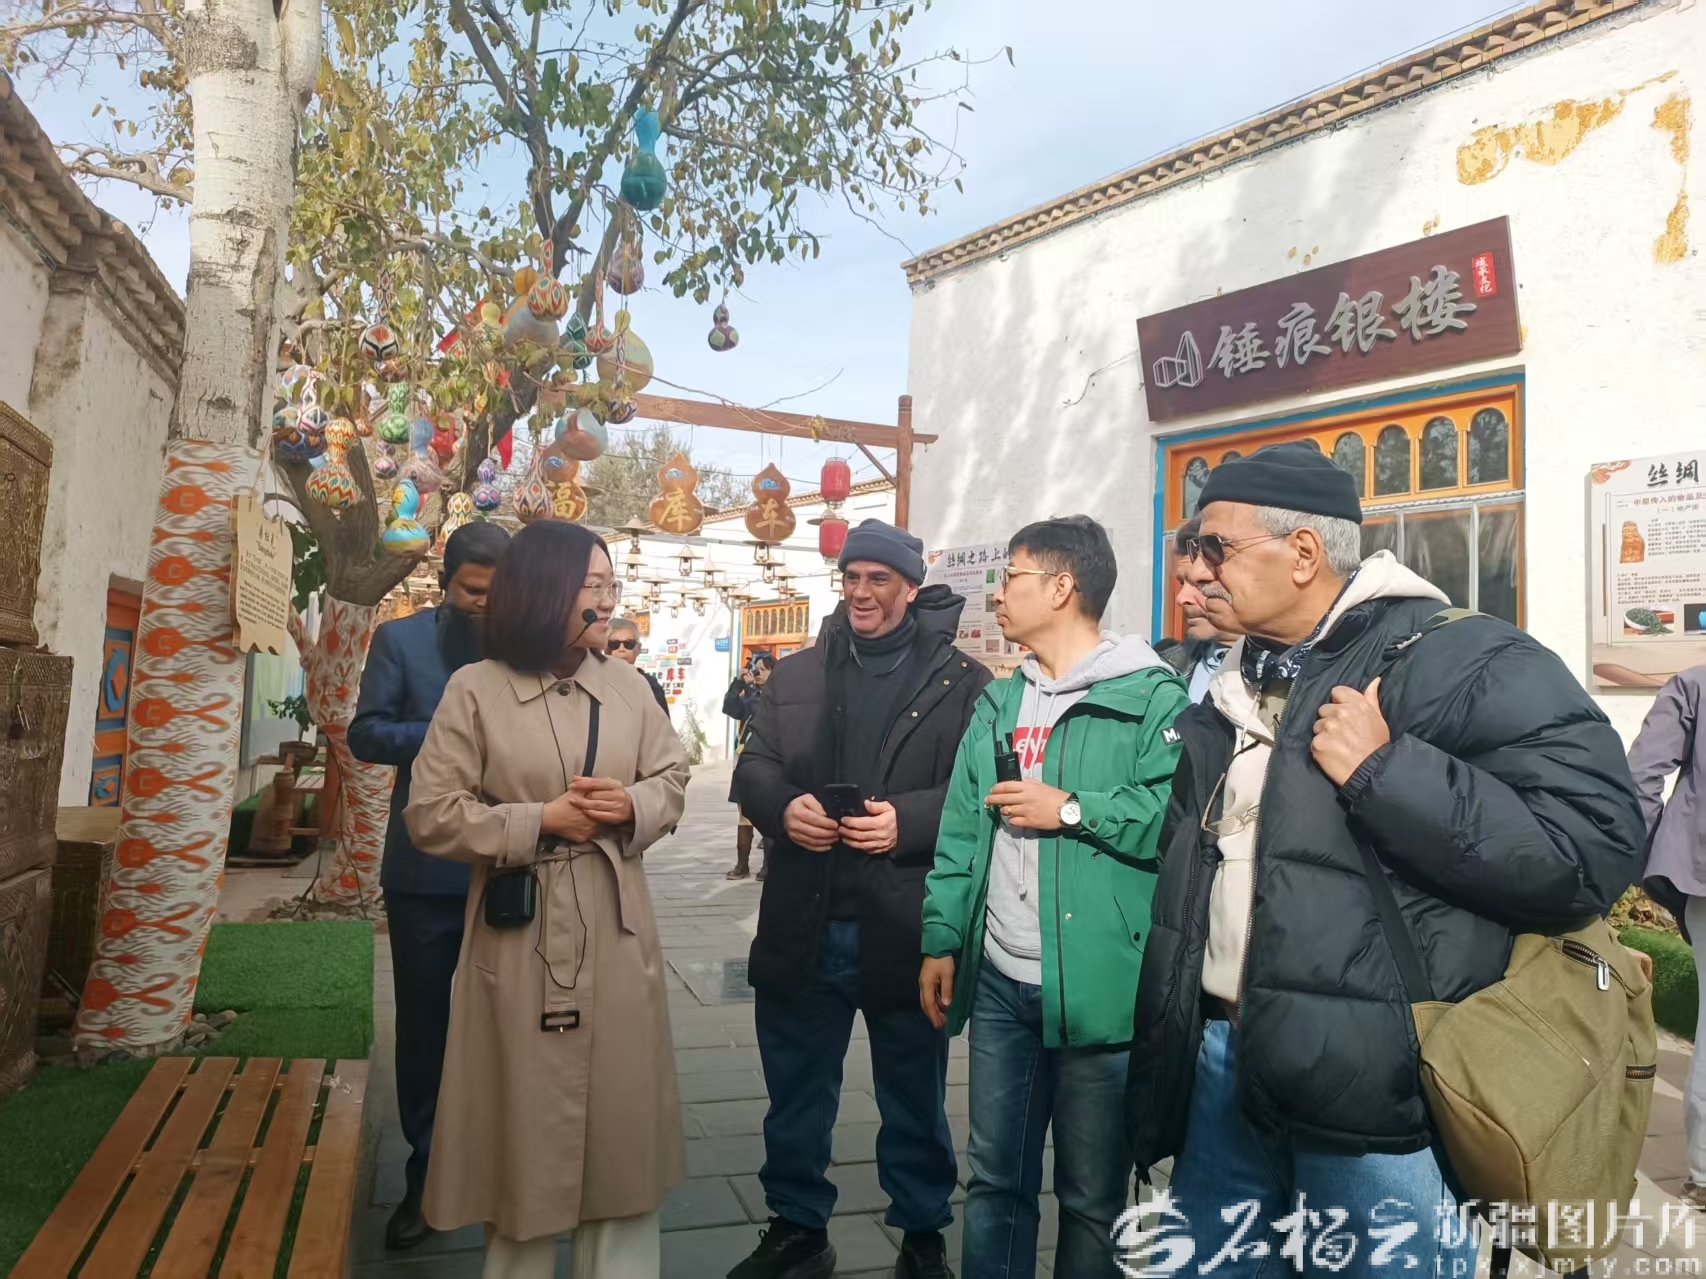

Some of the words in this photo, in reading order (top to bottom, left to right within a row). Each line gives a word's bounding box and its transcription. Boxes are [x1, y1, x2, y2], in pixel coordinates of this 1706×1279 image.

[1207, 265, 1477, 379] 锤痕银楼
[1647, 459, 1699, 487] 丝绸
[658, 487, 693, 532] 库
[755, 498, 785, 538] 车
